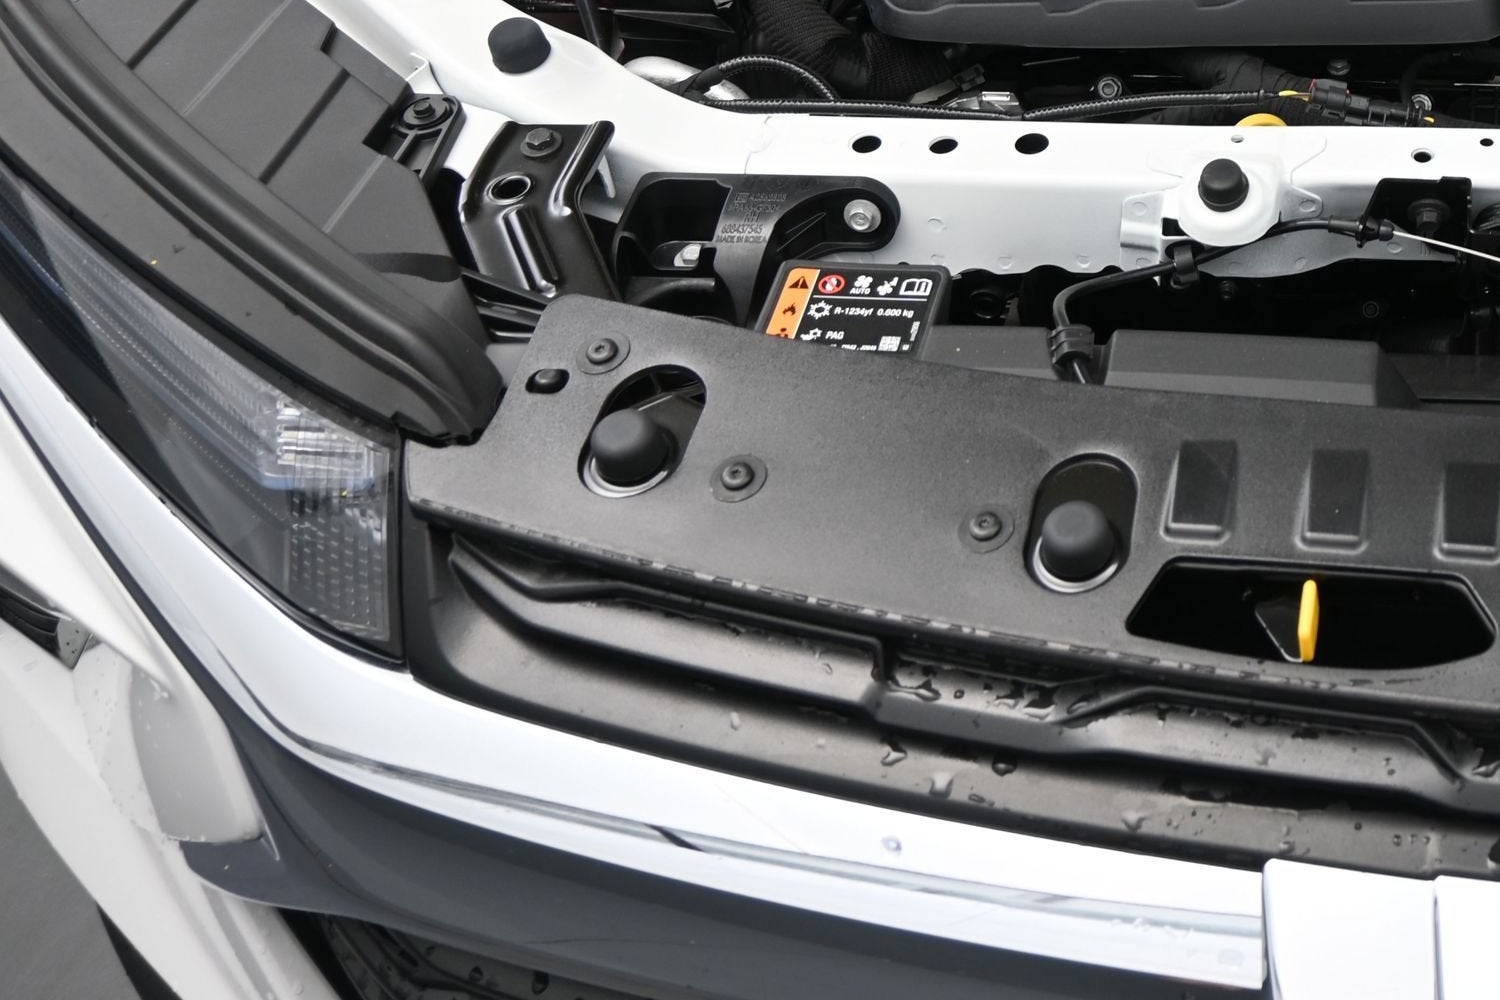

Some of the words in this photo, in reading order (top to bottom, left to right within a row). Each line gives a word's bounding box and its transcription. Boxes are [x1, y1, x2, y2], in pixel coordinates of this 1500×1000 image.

[716, 235, 735, 243] MADE
[736, 235, 744, 243] IN
[744, 235, 767, 243] KOREA
[850, 287, 871, 295] AUTO
[834, 306, 874, 317] R-1234yf
[902, 309, 914, 319] kg
[825, 330, 844, 340] PAG
